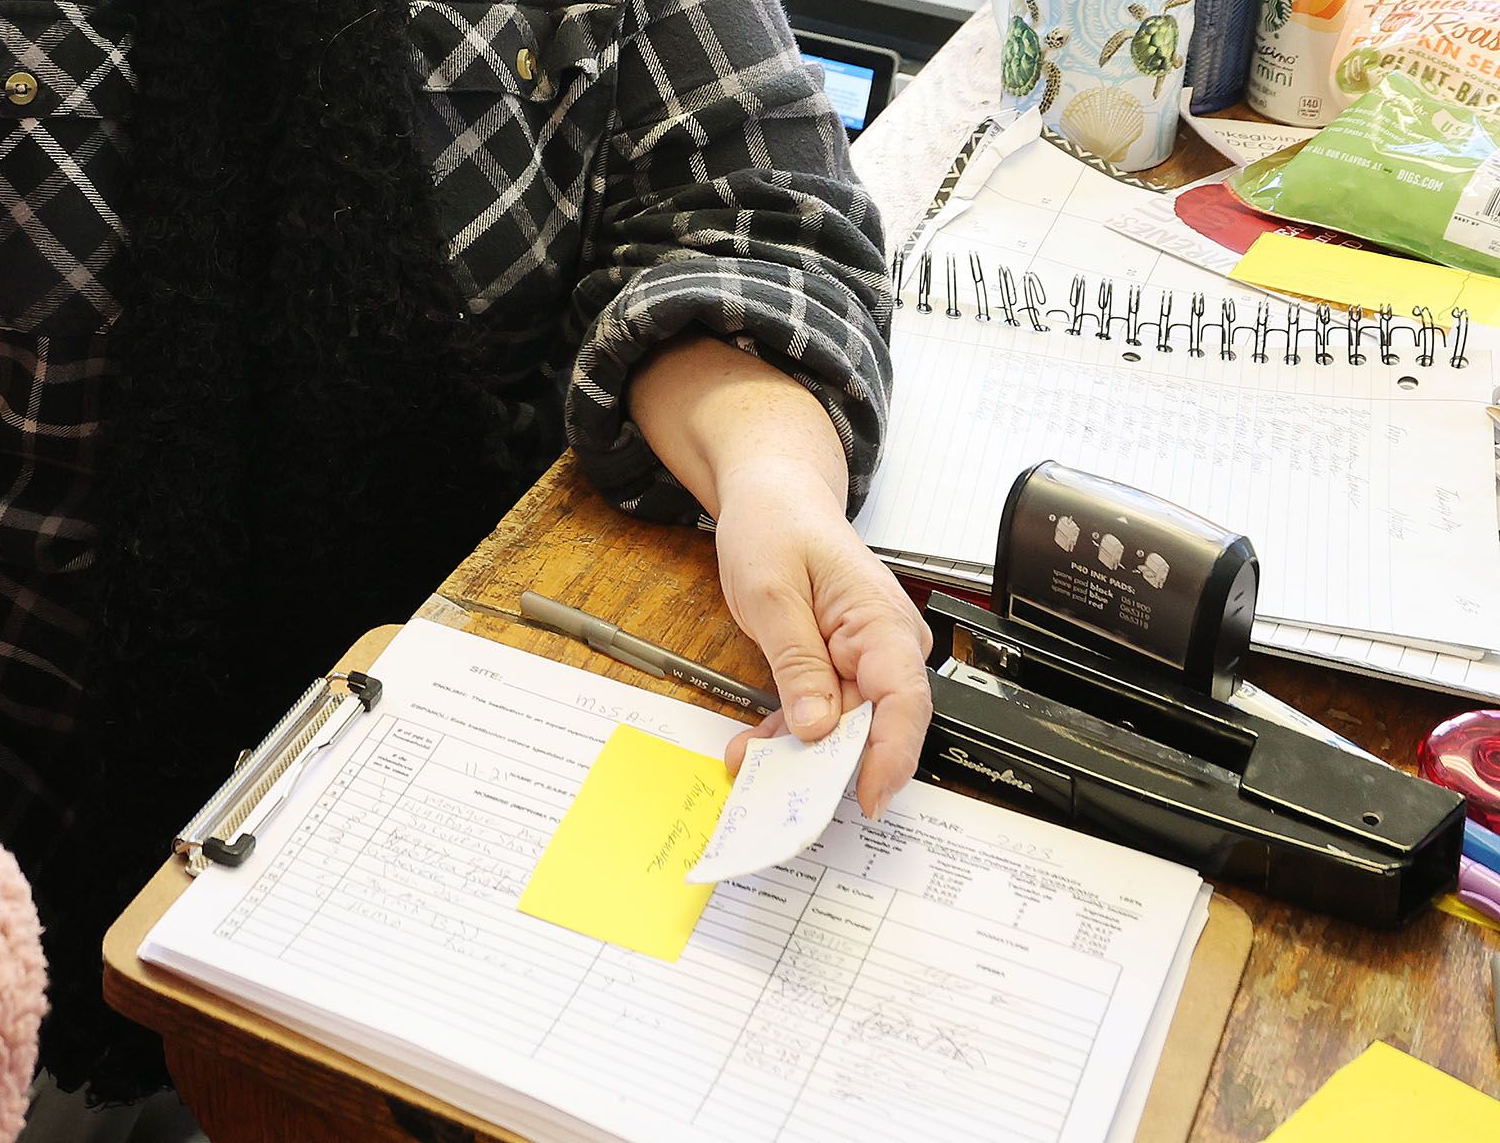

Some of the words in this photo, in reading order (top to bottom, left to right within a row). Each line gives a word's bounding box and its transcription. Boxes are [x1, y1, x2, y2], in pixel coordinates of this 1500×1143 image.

[1256, 63, 1294, 88] mini
[1301, 98, 1319, 110] 140
[1342, 153, 1371, 168] FLAVORS
[1396, 169, 1445, 192] BIGS.COM
[1071, 561, 1089, 575] P40
[1090, 570, 1107, 583] INK
[1109, 575, 1136, 595] PADS:
[1073, 575, 1089, 587] pad
[1090, 582, 1114, 598] black
[1088, 600, 1104, 610] red
[1089, 590, 1108, 604] blue
[469, 665, 503, 682] SITE:
[672, 668, 683, 678] M
[689, 676, 708, 690] Stic
[711, 686, 751, 707] Round
[939, 746, 1034, 794] Swingline
[918, 812, 964, 835] YEAR:
